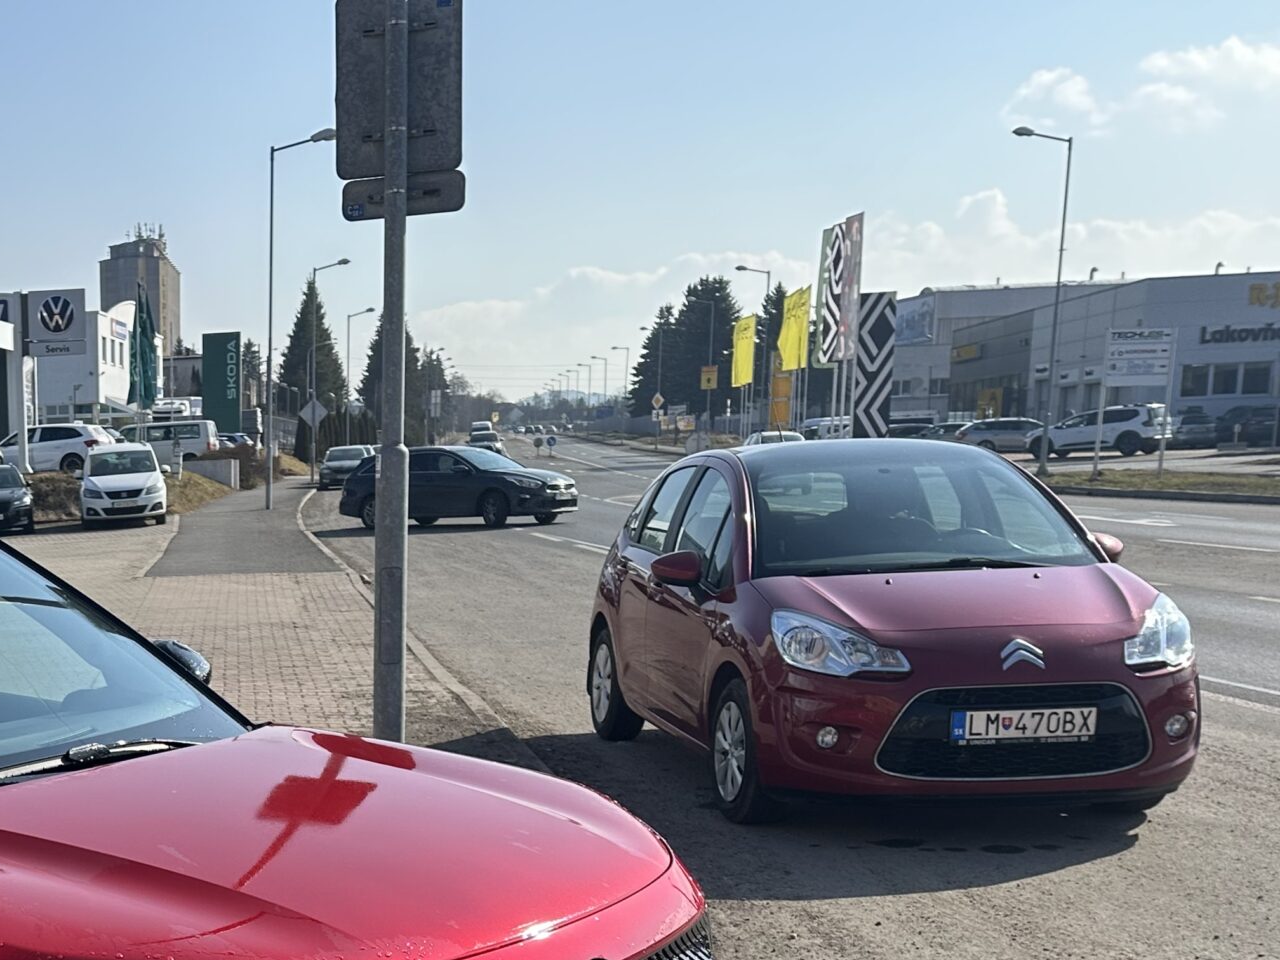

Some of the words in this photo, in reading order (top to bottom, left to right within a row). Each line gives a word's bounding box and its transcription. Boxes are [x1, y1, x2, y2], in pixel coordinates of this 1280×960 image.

[45, 344, 70, 354] Servis
[227, 340, 237, 399] SKODA
[969, 713, 1000, 736] LM
[1014, 710, 1093, 735] 470BX
